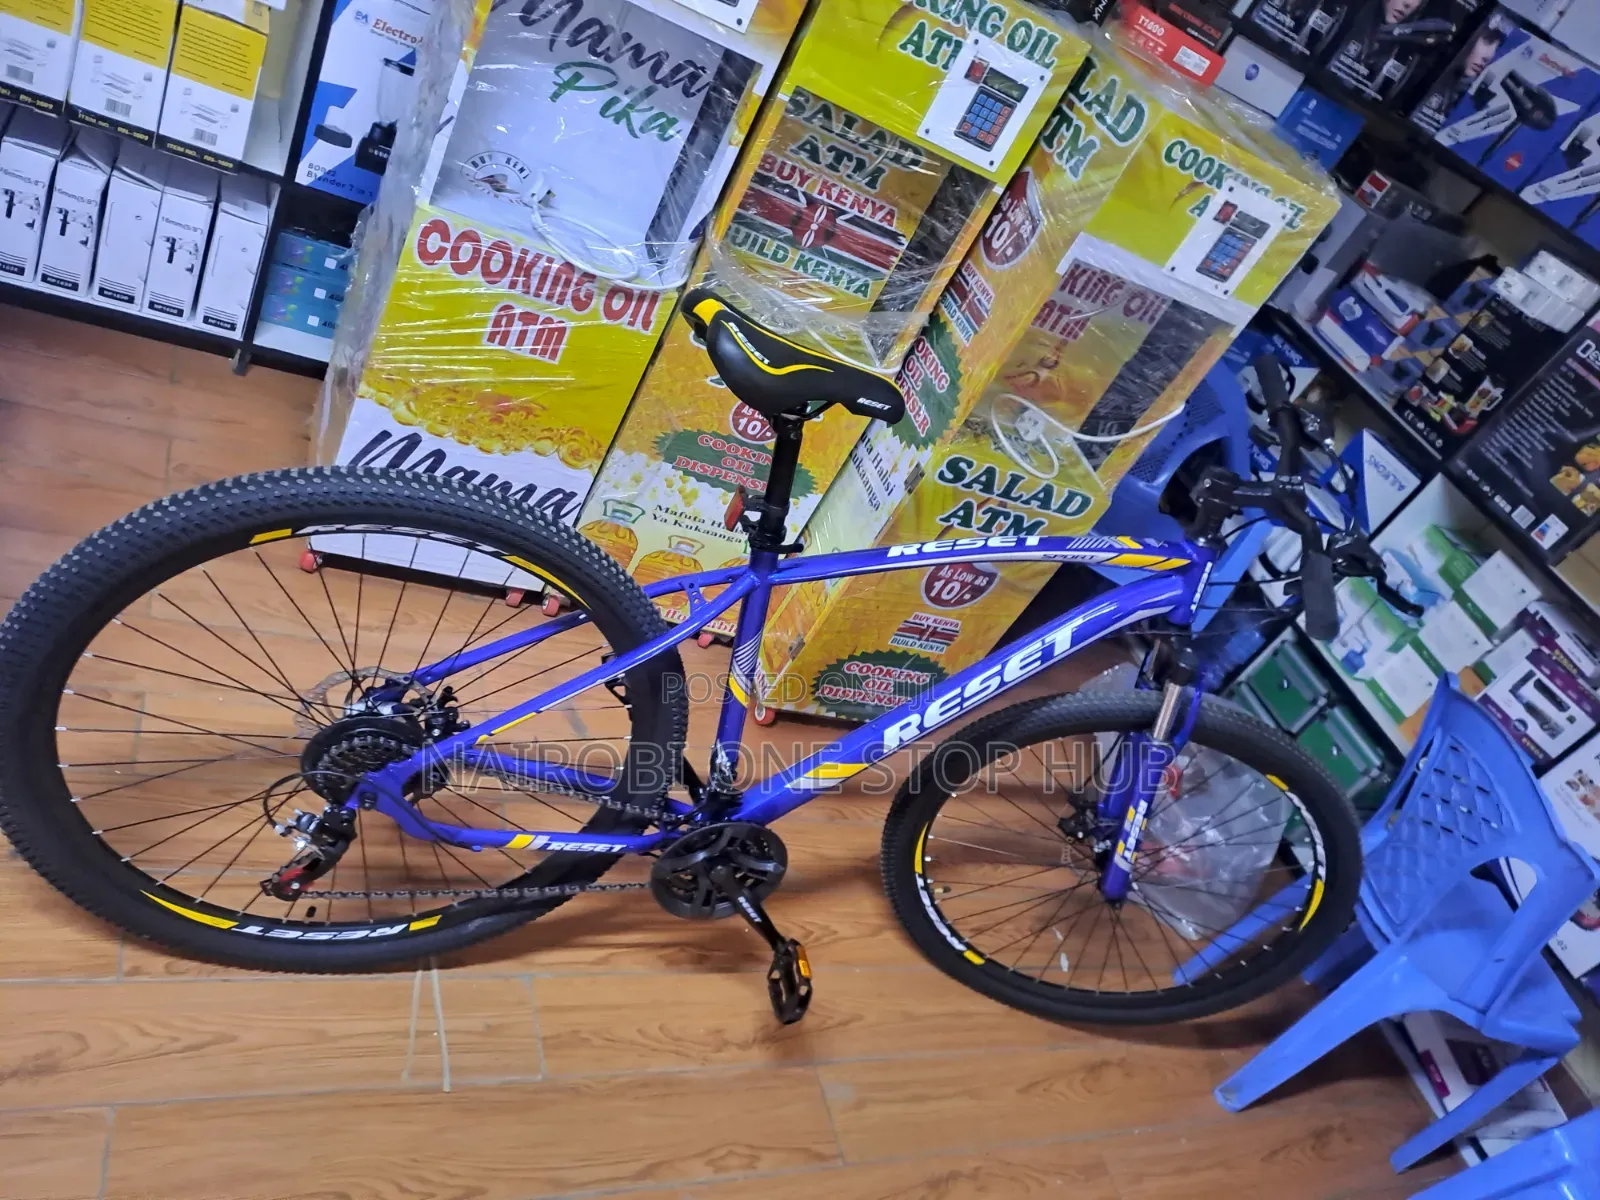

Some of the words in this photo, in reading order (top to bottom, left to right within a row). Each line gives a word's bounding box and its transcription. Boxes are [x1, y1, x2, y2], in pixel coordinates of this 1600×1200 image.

[1005, 19, 1061, 70] OIL
[548, 61, 683, 142] Pika
[1066, 55, 1146, 144] LAD
[785, 86, 926, 170] SALAD
[1042, 103, 1099, 180] TM
[790, 134, 888, 192] ATM
[758, 152, 813, 190] BUY
[814, 175, 898, 230] KENYA
[417, 218, 597, 314] COOKING
[602, 284, 663, 333] OIL
[728, 223, 791, 265] UILD
[792, 250, 873, 299] KENYA
[963, 263, 978, 281] BUY
[974, 279, 993, 309] KENYA
[1059, 263, 1127, 305] KING
[1122, 290, 1166, 325] OIL
[483, 303, 570, 364] ATM
[727, 321, 771, 365] RESET
[905, 355, 924, 391] OIL
[914, 336, 950, 393] OKING
[857, 397, 892, 411] RESET
[697, 434, 772, 465] COOKIN
[721, 456, 754, 475] OIL
[851, 453, 882, 512] ukaanga
[872, 452, 897, 497] Halisi
[938, 455, 1094, 518] SALAD
[652, 512, 668, 523] Ya
[673, 519, 743, 544] Kukaanga
[654, 503, 706, 524] Mafuta
[939, 499, 1049, 537] ATM
[887, 535, 1048, 558] RESET
[1041, 552, 1096, 562] SPORT
[938, 564, 954, 578] As
[952, 567, 976, 584] Low
[912, 613, 930, 622] BUY
[931, 615, 960, 629] KENYA
[890, 637, 917, 648] BUILD
[916, 643, 946, 653] KENYA
[844, 662, 931, 684] COOKING
[864, 678, 895, 693] OIL
[883, 619, 1082, 755] RESET
[545, 841, 628, 854] RESET
[231, 922, 413, 941] RESET
